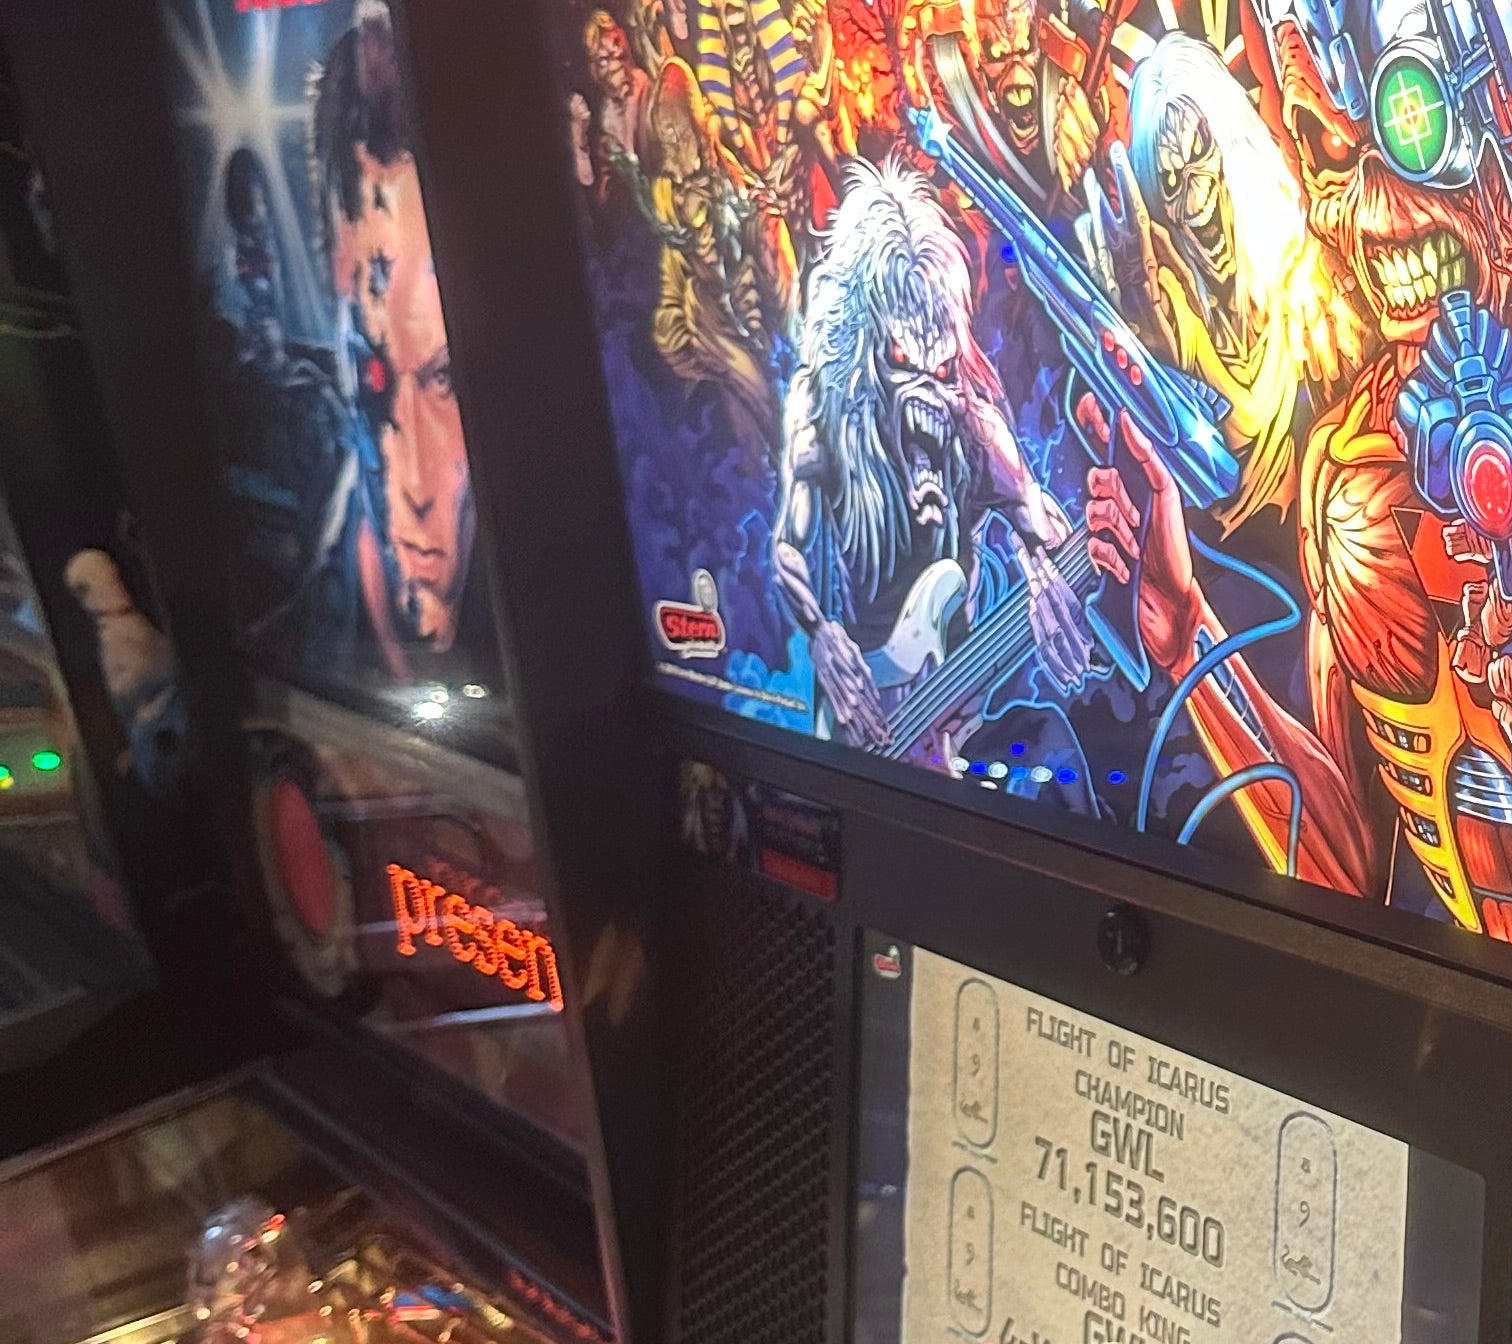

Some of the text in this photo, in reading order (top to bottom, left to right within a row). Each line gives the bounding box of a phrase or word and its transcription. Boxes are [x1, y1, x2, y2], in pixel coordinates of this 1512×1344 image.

[665, 613, 719, 640] Stern
[1027, 1006, 1230, 1115] FLIGHT OF ICARUS
[1075, 1069, 1185, 1141] CHAMPION
[1090, 1109, 1165, 1183] GWL
[1035, 1135, 1225, 1269] 71,153,600
[1020, 1201, 1221, 1328] FLIGHT OF ICARUS
[1056, 1262, 1126, 1322] COMBO
